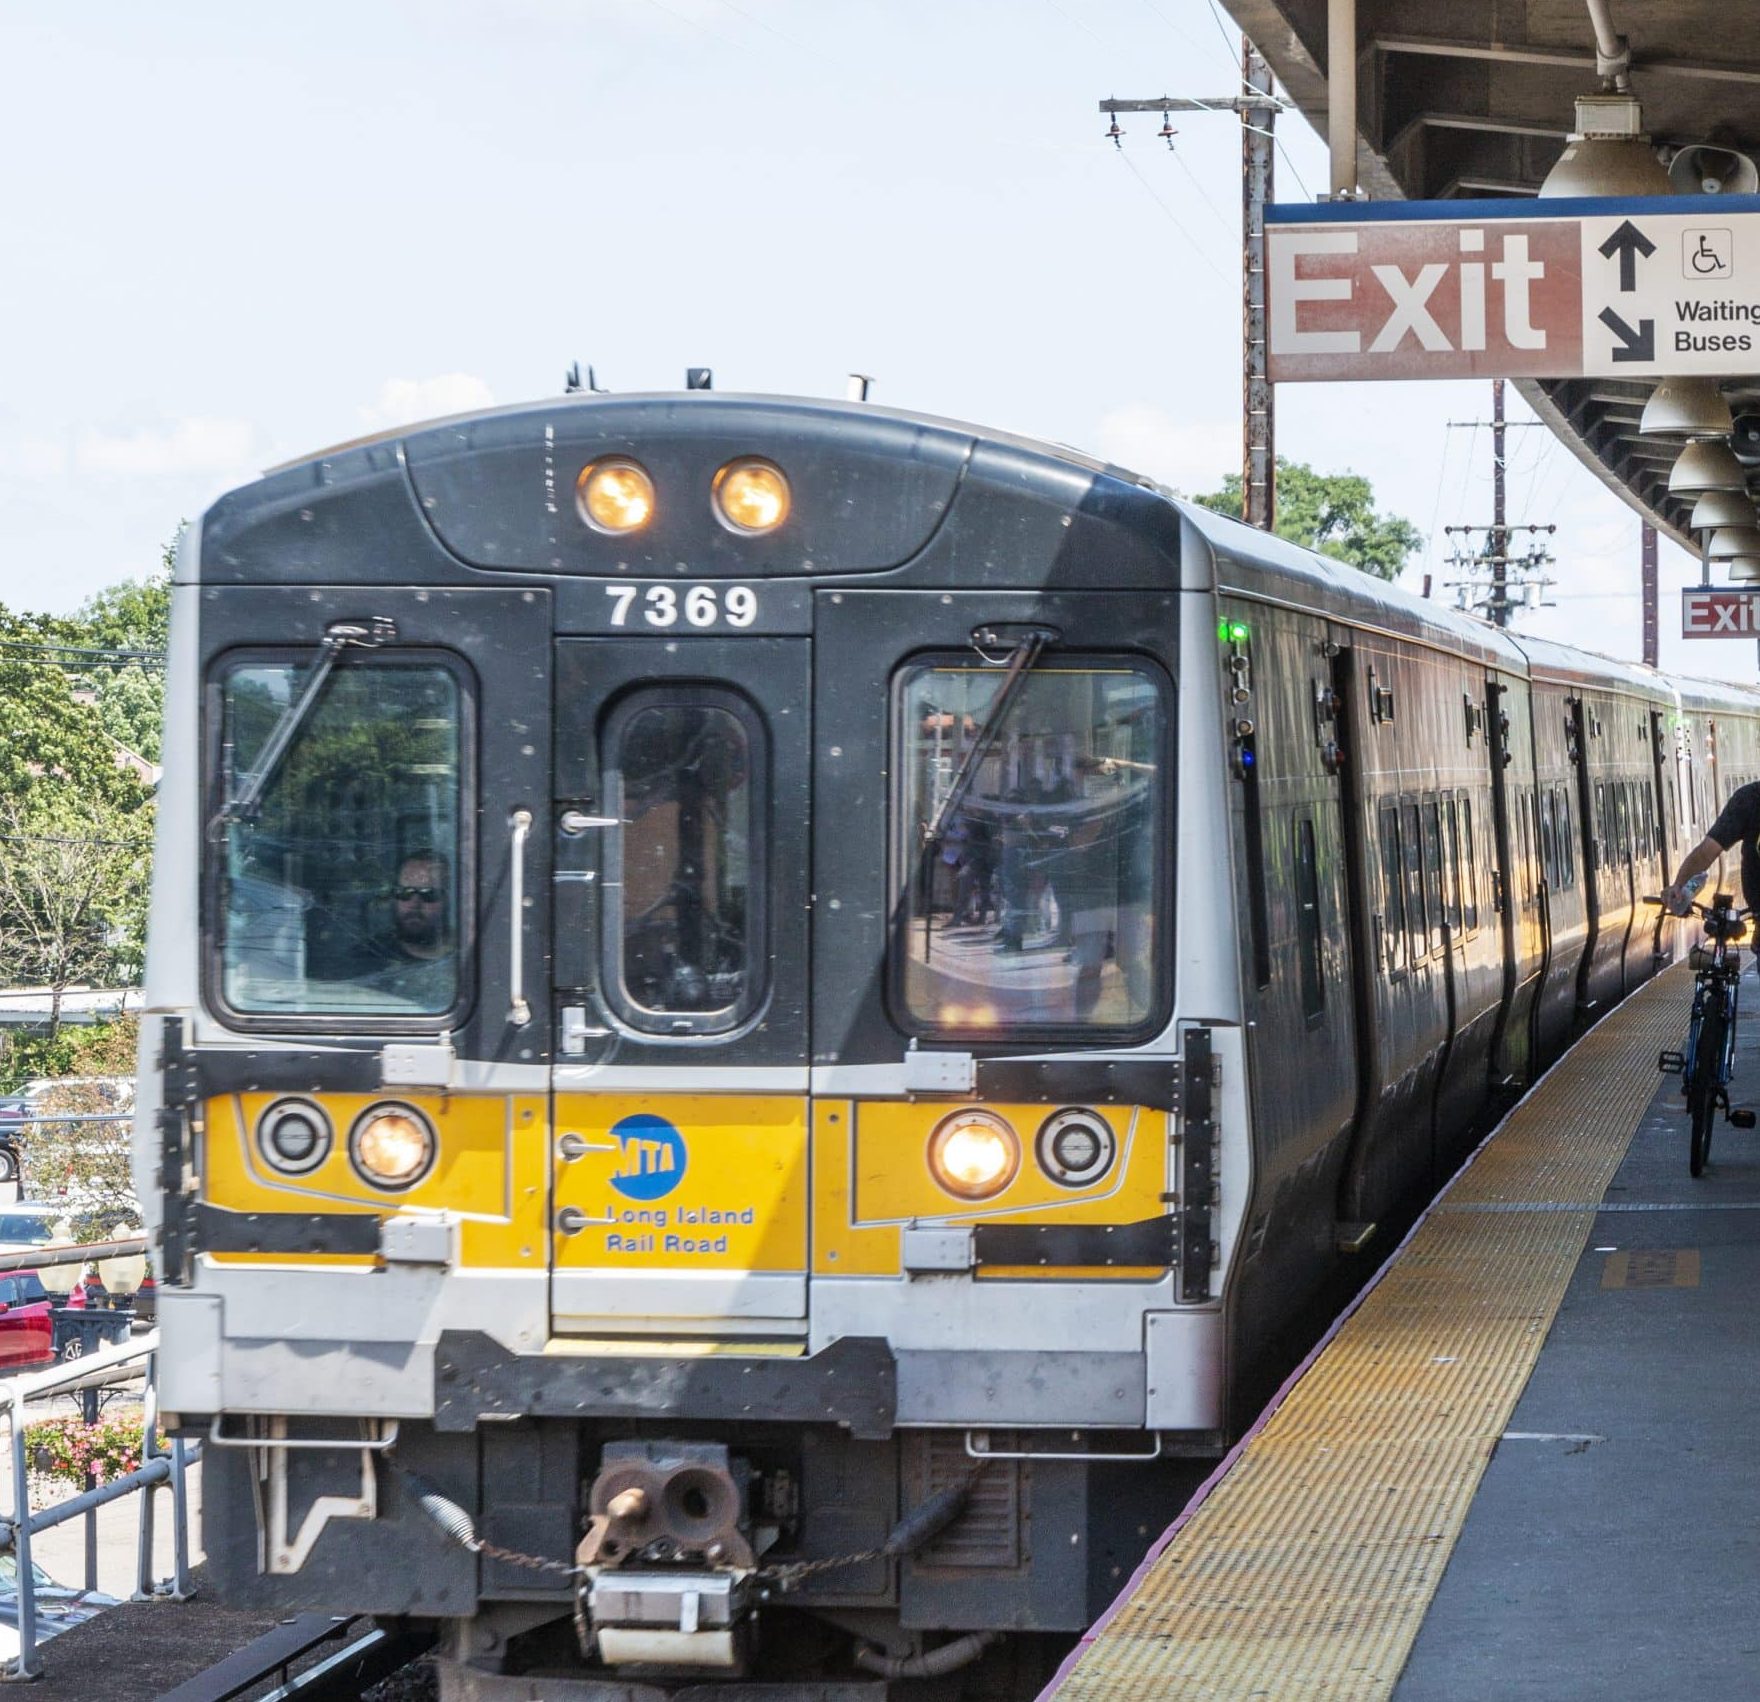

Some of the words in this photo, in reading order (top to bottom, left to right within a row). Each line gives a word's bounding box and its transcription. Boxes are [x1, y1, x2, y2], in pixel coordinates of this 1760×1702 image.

[1268, 229, 1547, 355] Exit
[1675, 300, 1760, 325] Waiting
[1675, 331, 1752, 352] Buses
[605, 585, 757, 627] 7369
[607, 1206, 667, 1228] Long
[678, 1206, 754, 1225] Island
[607, 1234, 654, 1252] Rail
[665, 1234, 728, 1253] Road
